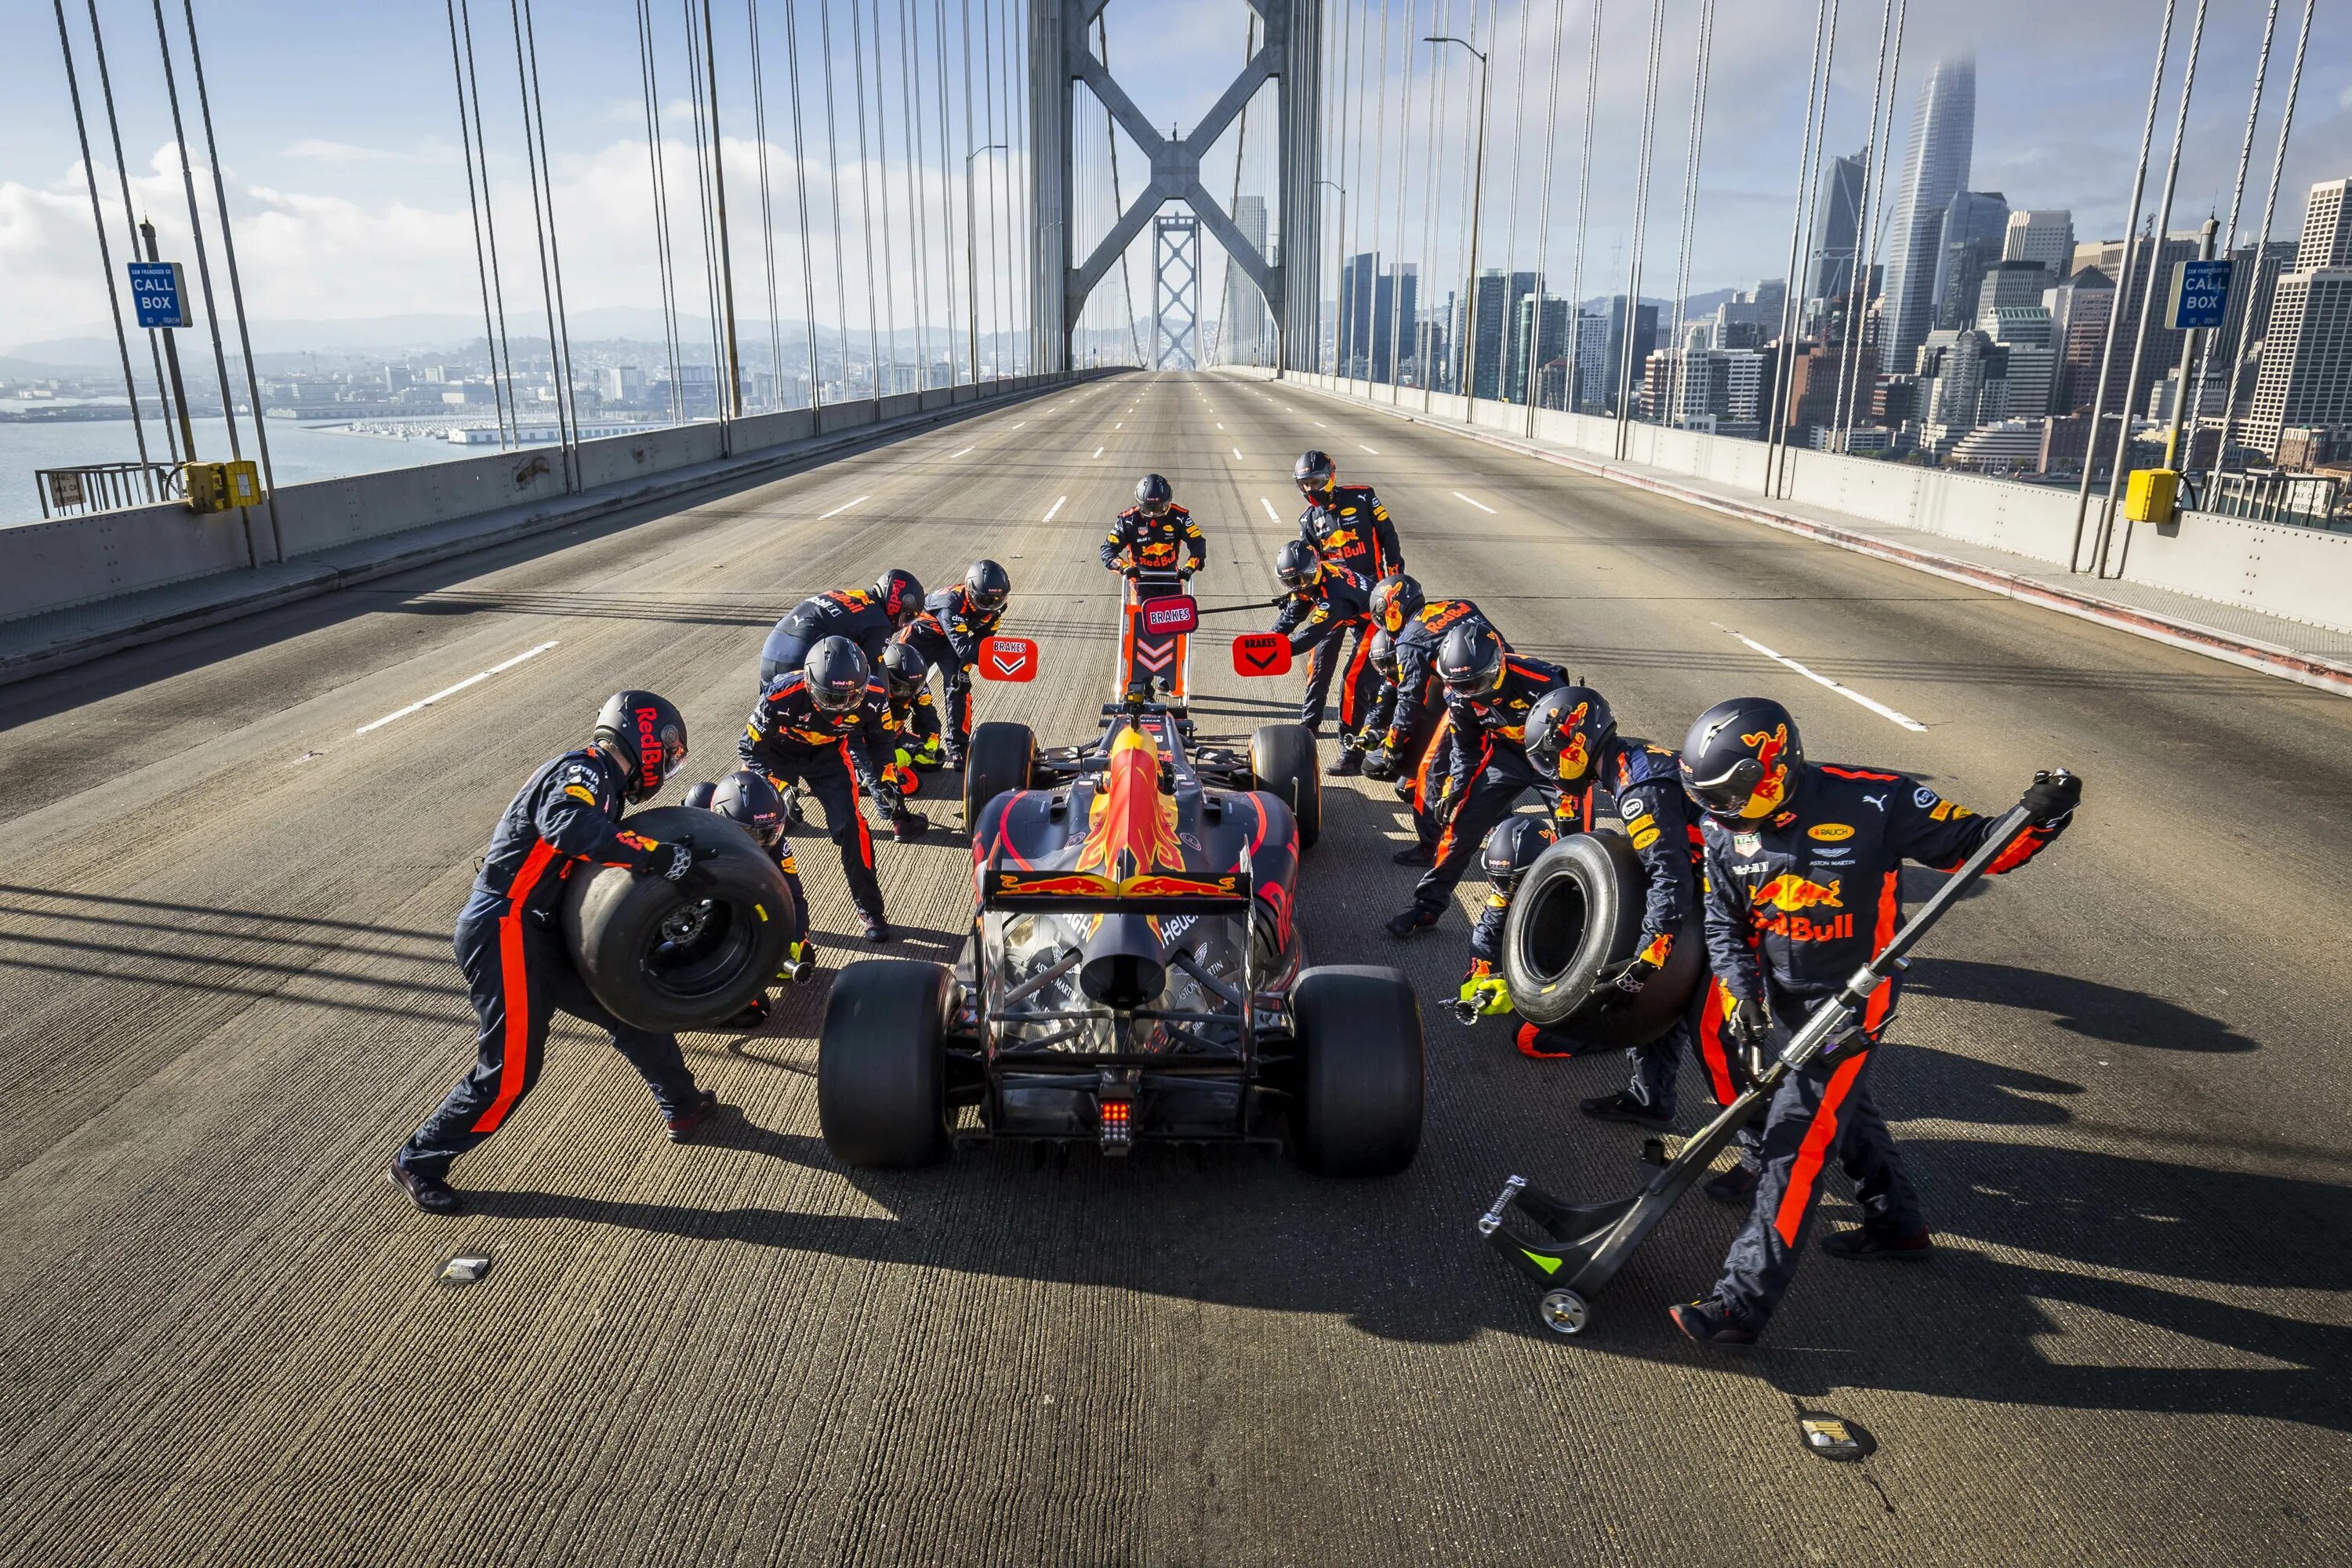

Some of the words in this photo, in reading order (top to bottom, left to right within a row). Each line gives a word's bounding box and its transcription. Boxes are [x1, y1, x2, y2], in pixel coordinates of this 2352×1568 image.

[134, 279, 173, 291] CALL
[2186, 278, 2227, 290] CALL
[141, 297, 172, 309] BOX
[2187, 296, 2218, 309] BOX
[1150, 608, 1190, 625] BRAKES
[993, 641, 1025, 652] BRAKES
[1245, 638, 1276, 649] BRAKES
[1054, 978, 1079, 1004] MARTIN
